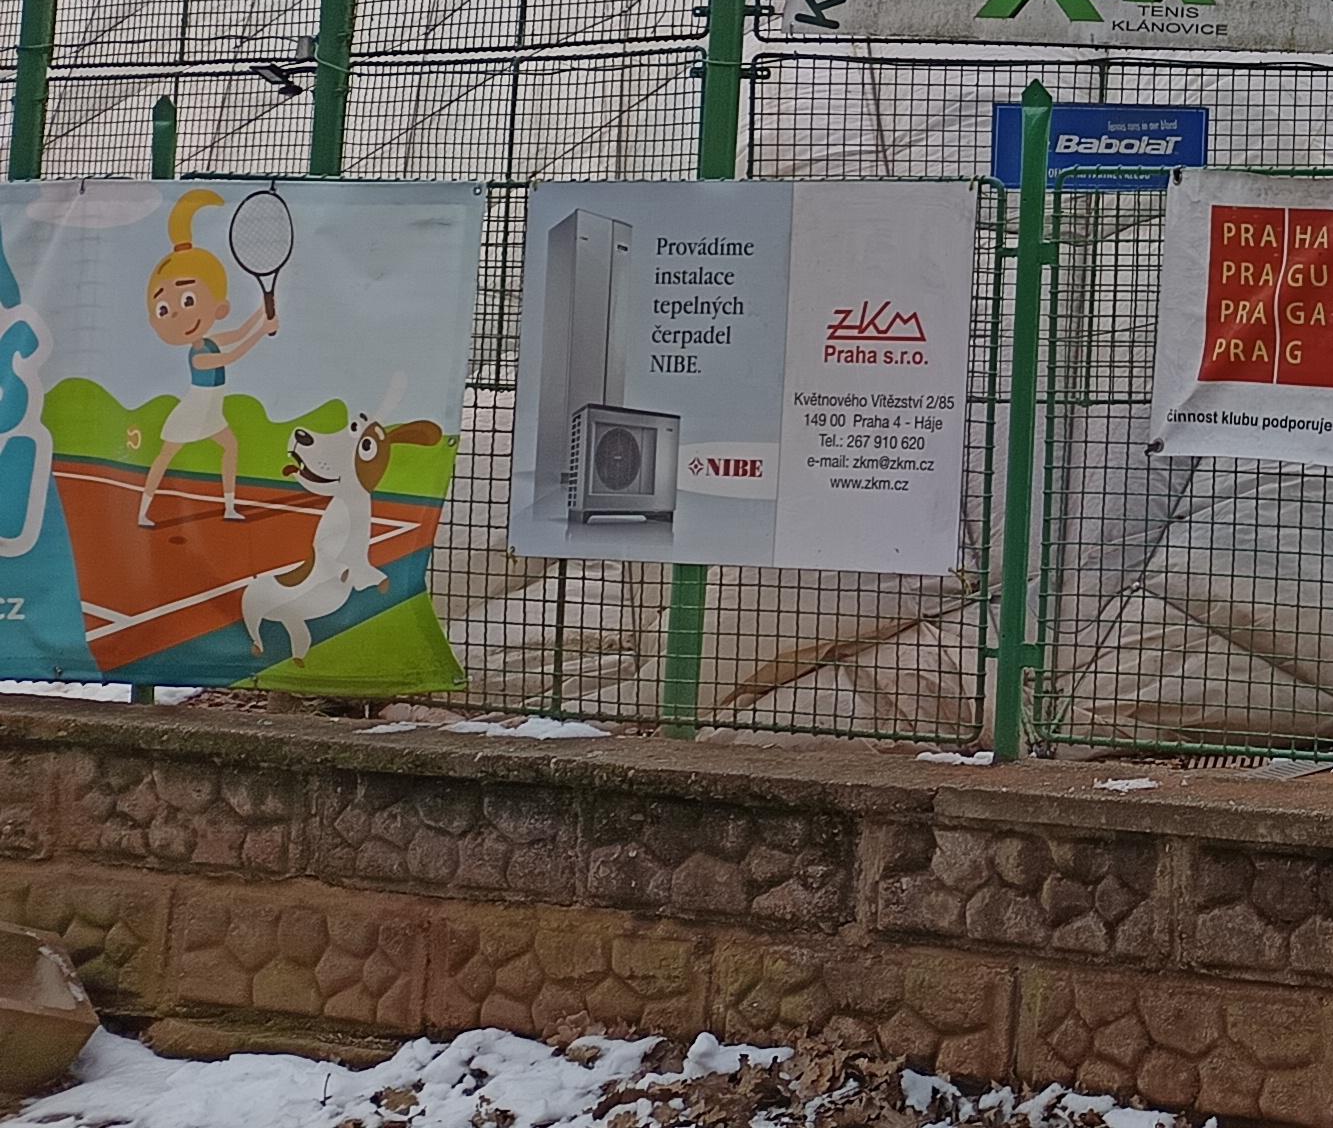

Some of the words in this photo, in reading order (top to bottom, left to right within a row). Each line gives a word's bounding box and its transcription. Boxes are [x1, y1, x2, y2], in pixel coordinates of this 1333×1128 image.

[1138, 5, 1199, 18] TENIS
[1112, 19, 1228, 36] KLÁNOVICE
[656, 236, 754, 256] Provádíme
[655, 266, 735, 285] instalace
[653, 295, 744, 320] tepelných
[651, 324, 731, 349] čerpadel
[650, 354, 701, 373] NIBE.
[824, 345, 877, 364] Praha
[883, 350, 928, 365] s.r.o.
[793, 392, 867, 408] Květnového
[871, 394, 923, 409] Vítězství
[926, 395, 955, 410] 2/85
[804, 414, 826, 427] 149
[830, 414, 846, 427] 00
[853, 414, 889, 428] Praha
[893, 416, 901, 428] 4
[914, 416, 943, 432] Háje
[1167, 409, 1218, 424] činnost
[1222, 411, 1258, 426] klubu
[1262, 416, 1332, 434] podporuje
[819, 434, 843, 448] Tel.:
[847, 435, 870, 448] 267
[874, 436, 898, 449] 910
[901, 436, 925, 450] 620
[705, 458, 763, 478] NIBE
[807, 454, 850, 468] e-mail:
[852, 455, 934, 471] zkm@zkm.cz
[830, 477, 909, 491] www.zkm.cz
